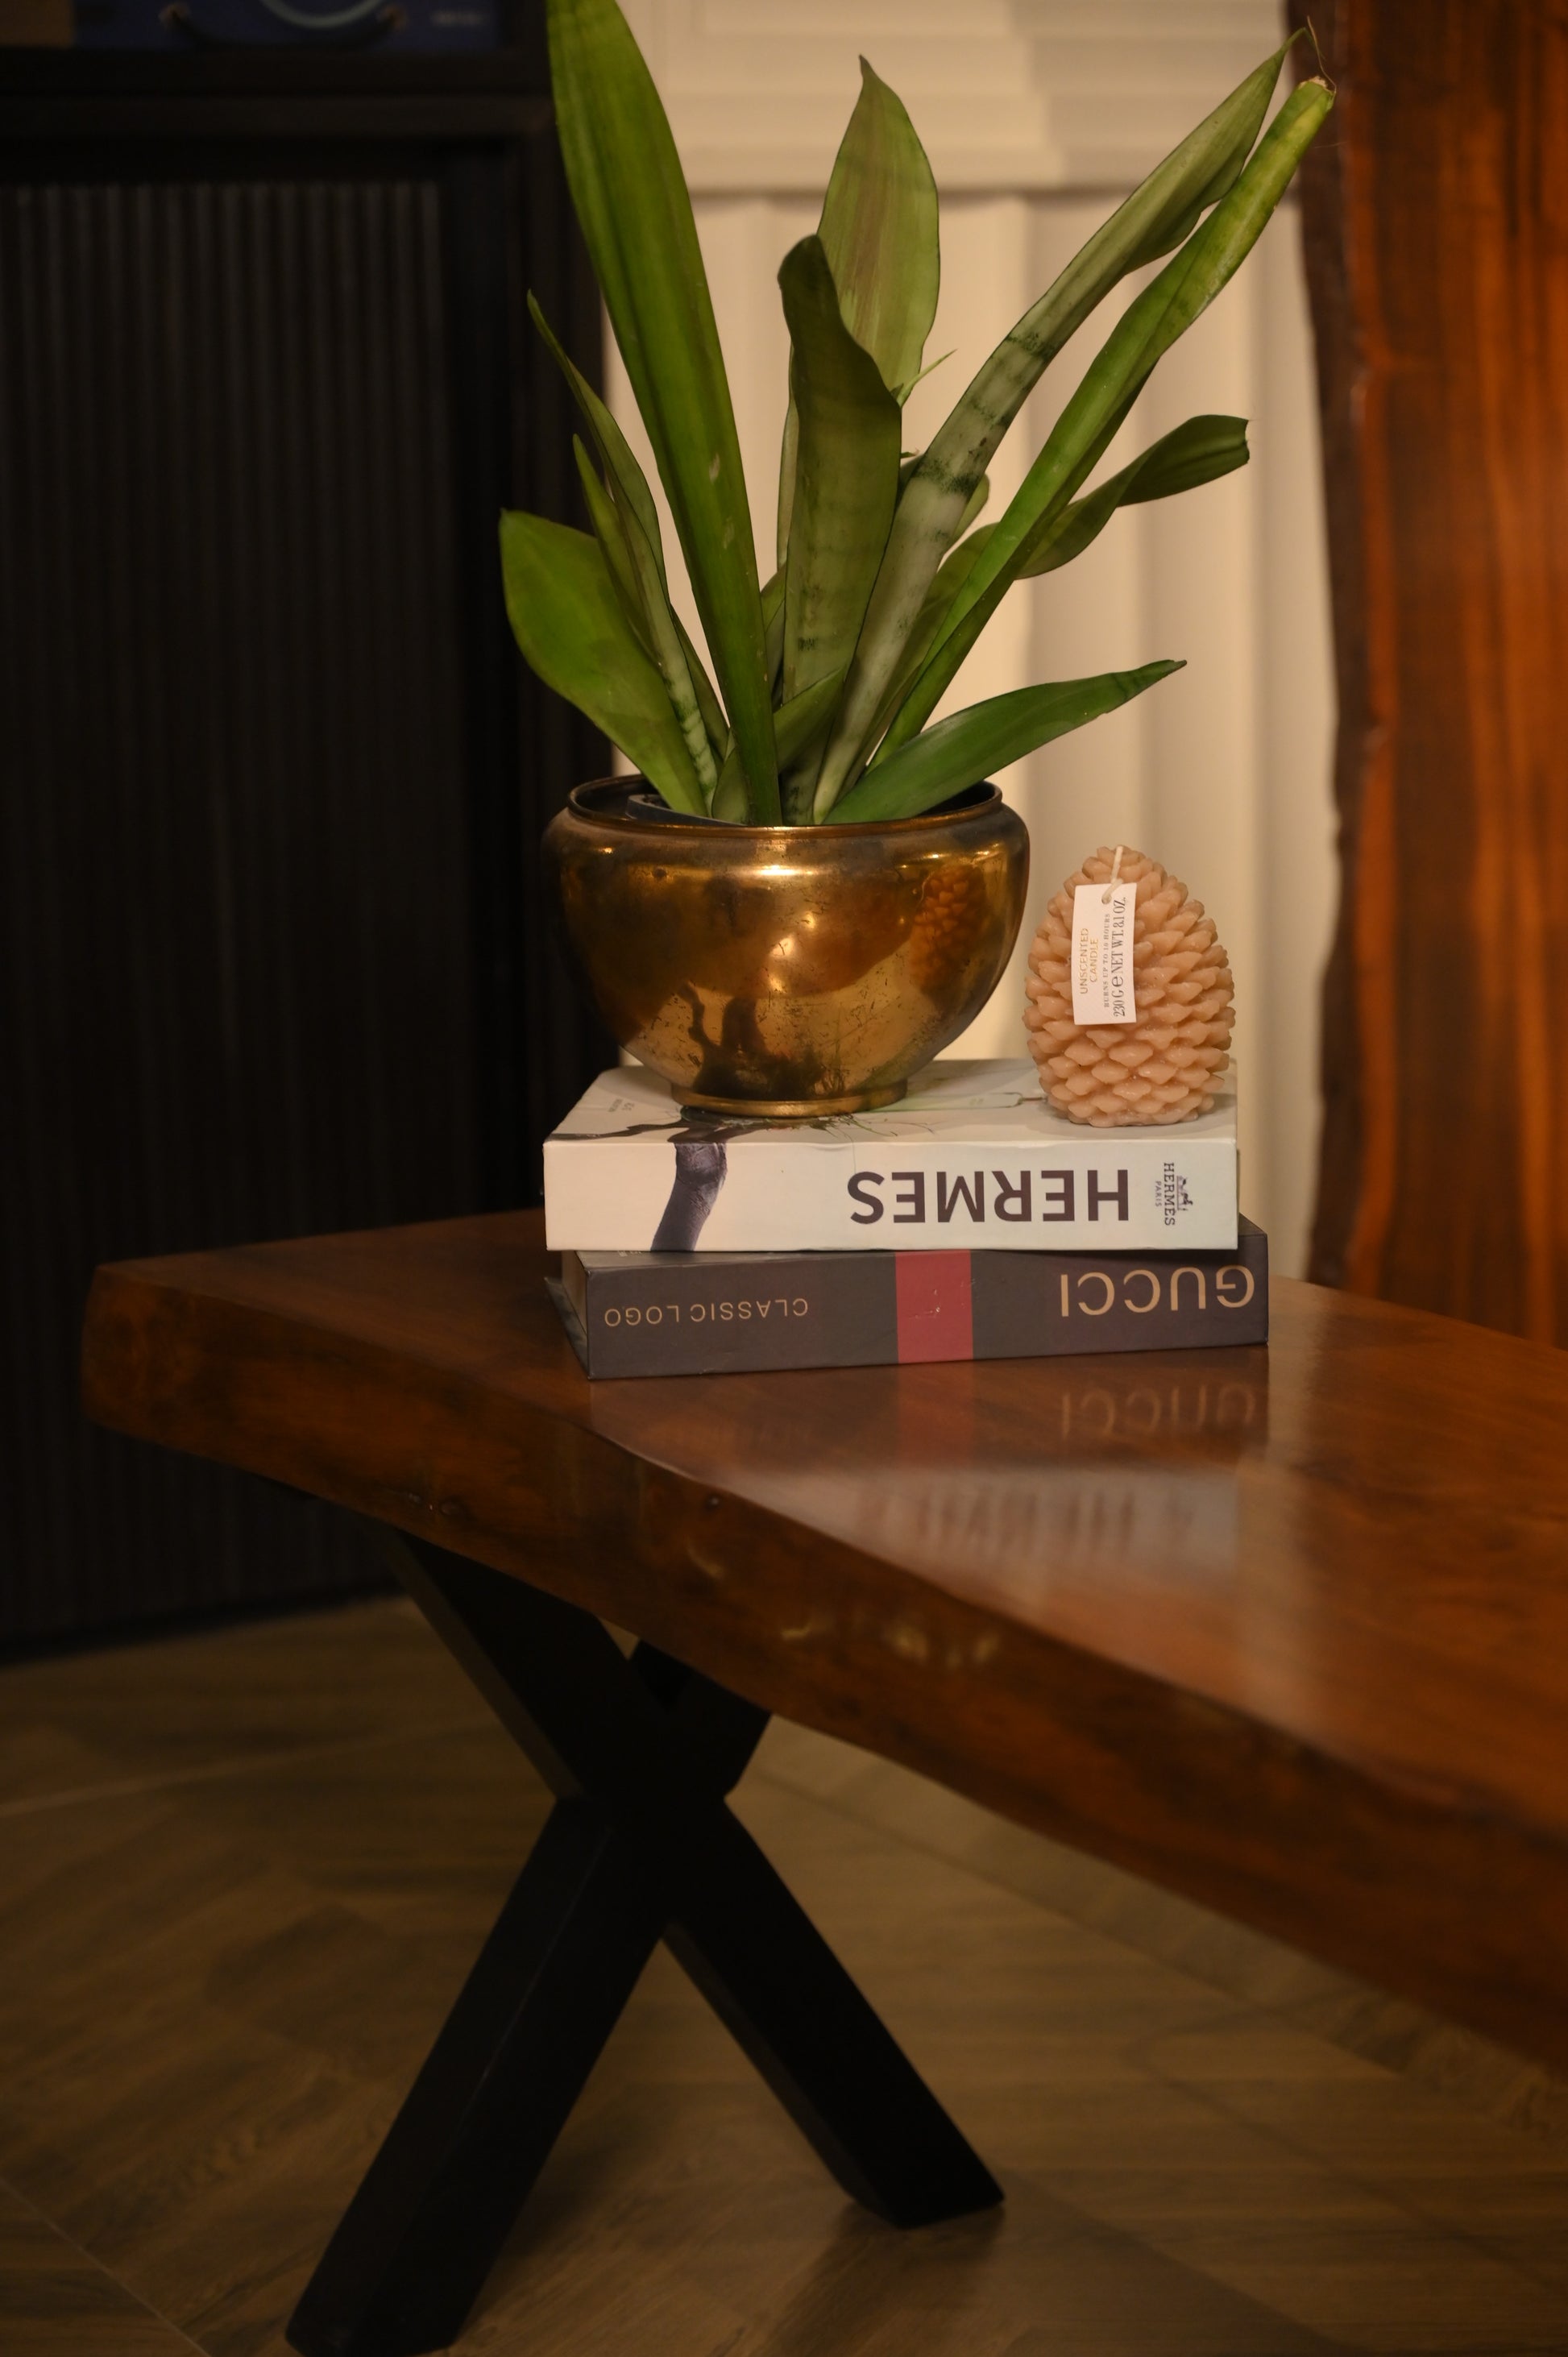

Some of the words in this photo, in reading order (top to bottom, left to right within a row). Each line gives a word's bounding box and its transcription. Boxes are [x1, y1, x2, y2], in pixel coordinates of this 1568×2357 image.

[1113, 897, 1126, 914] OZ.
[1112, 929, 1124, 948] WT.
[1080, 927, 1089, 994] UNSCENTED
[1090, 938, 1099, 983] CANDLE
[1102, 953, 1109, 965] TO
[1111, 951, 1123, 973] NET
[1102, 967, 1109, 979] UP
[1111, 990, 1125, 998] G
[1113, 1000, 1126, 1017] 230
[847, 1169, 1129, 1225] HERMES
[1060, 1264, 1255, 1317] GUCCI
[604, 1305, 681, 1327] LOGO
[690, 1298, 808, 1322] CLASSIC
